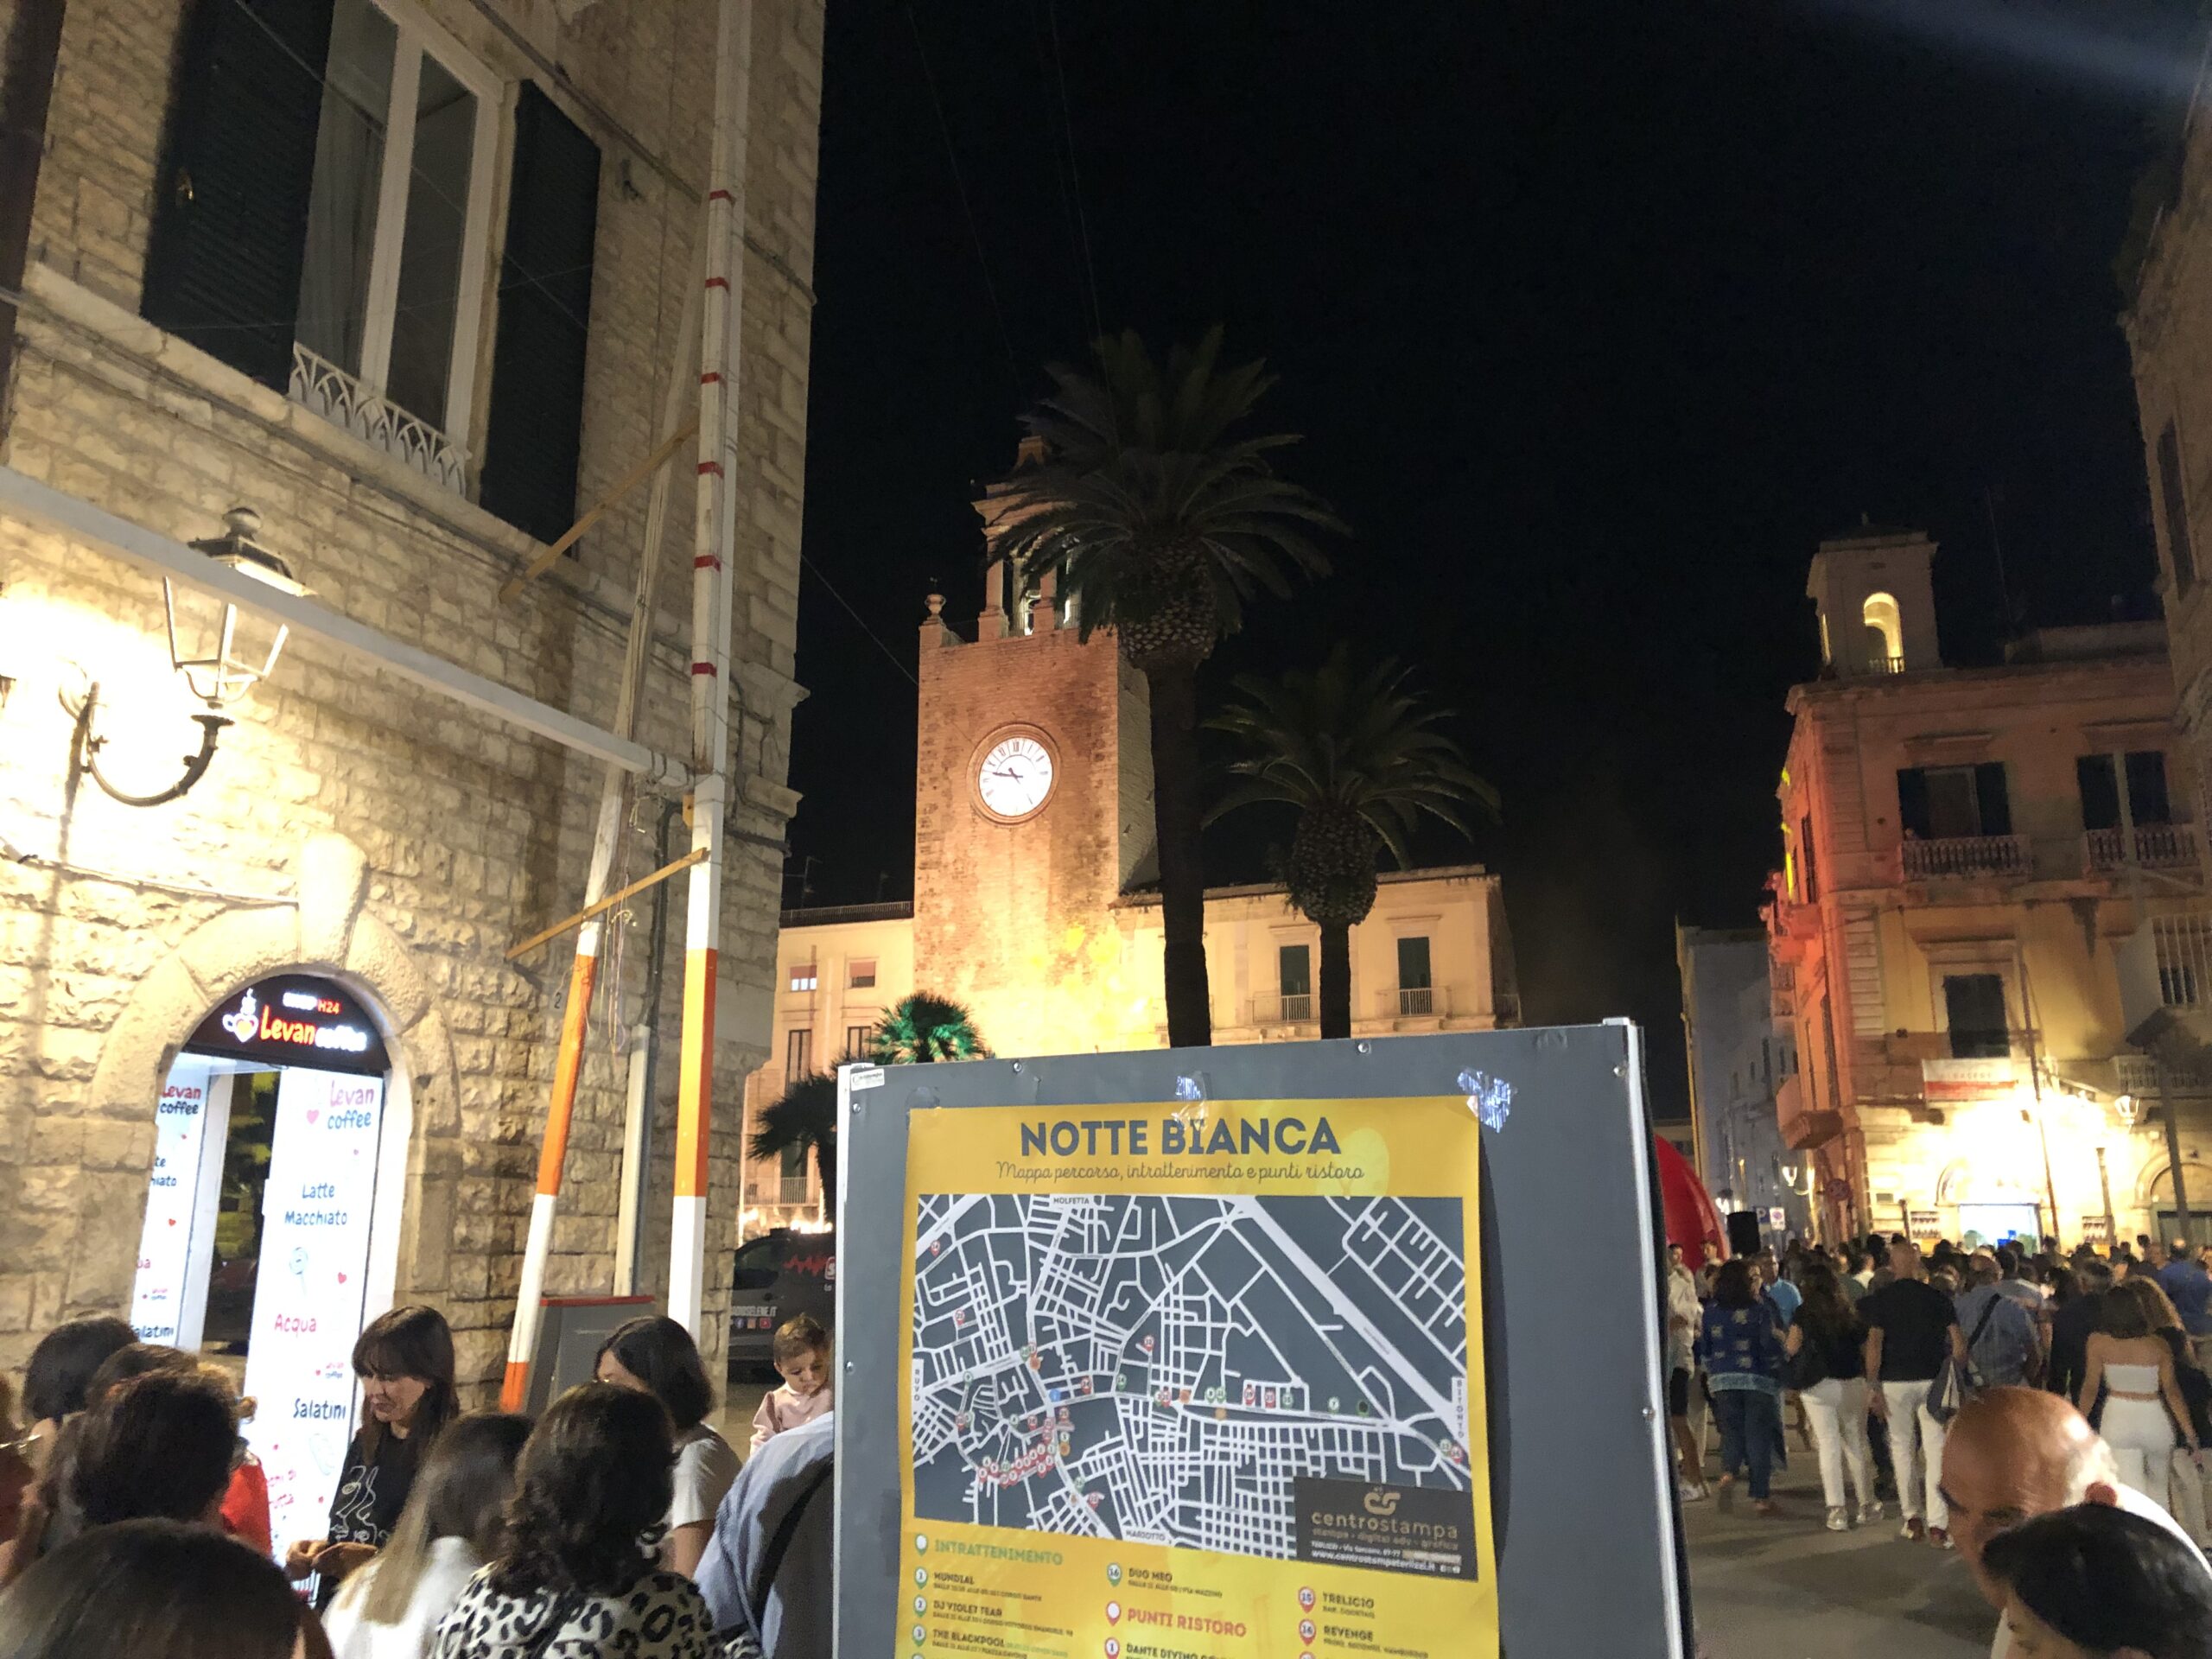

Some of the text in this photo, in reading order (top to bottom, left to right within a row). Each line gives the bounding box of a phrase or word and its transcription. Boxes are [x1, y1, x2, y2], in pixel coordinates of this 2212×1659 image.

[317, 999, 340, 1014] H24
[260, 1004, 316, 1046] Levan
[330, 1080, 374, 1107] Levan
[160, 1101, 199, 1116] coffee
[327, 1109, 372, 1130] coffee
[1020, 1116, 1342, 1157] NOTTE BIANCA
[996, 1160, 1365, 1185] Mappa percorso, intrattenimento e punti ristoro
[302, 1181, 335, 1199] Latte
[284, 1209, 348, 1226] Macchiato
[274, 1313, 317, 1338] Acqua
[293, 1398, 346, 1420] Salatini
[1311, 1511, 1458, 1541] centrostampa
[934, 1539, 1064, 1566] INTRATTENIMENTO
[1128, 1567, 1150, 1580] DUO
[947, 1602, 979, 1615] VIOLET
[1127, 1608, 1247, 1637] PUNTI RISTORO
[932, 1629, 950, 1639] THE
[951, 1631, 1005, 1648] BLACKPOOL
[1323, 1624, 1374, 1643] REVENGE
[1126, 1643, 1158, 1658] DANTE
